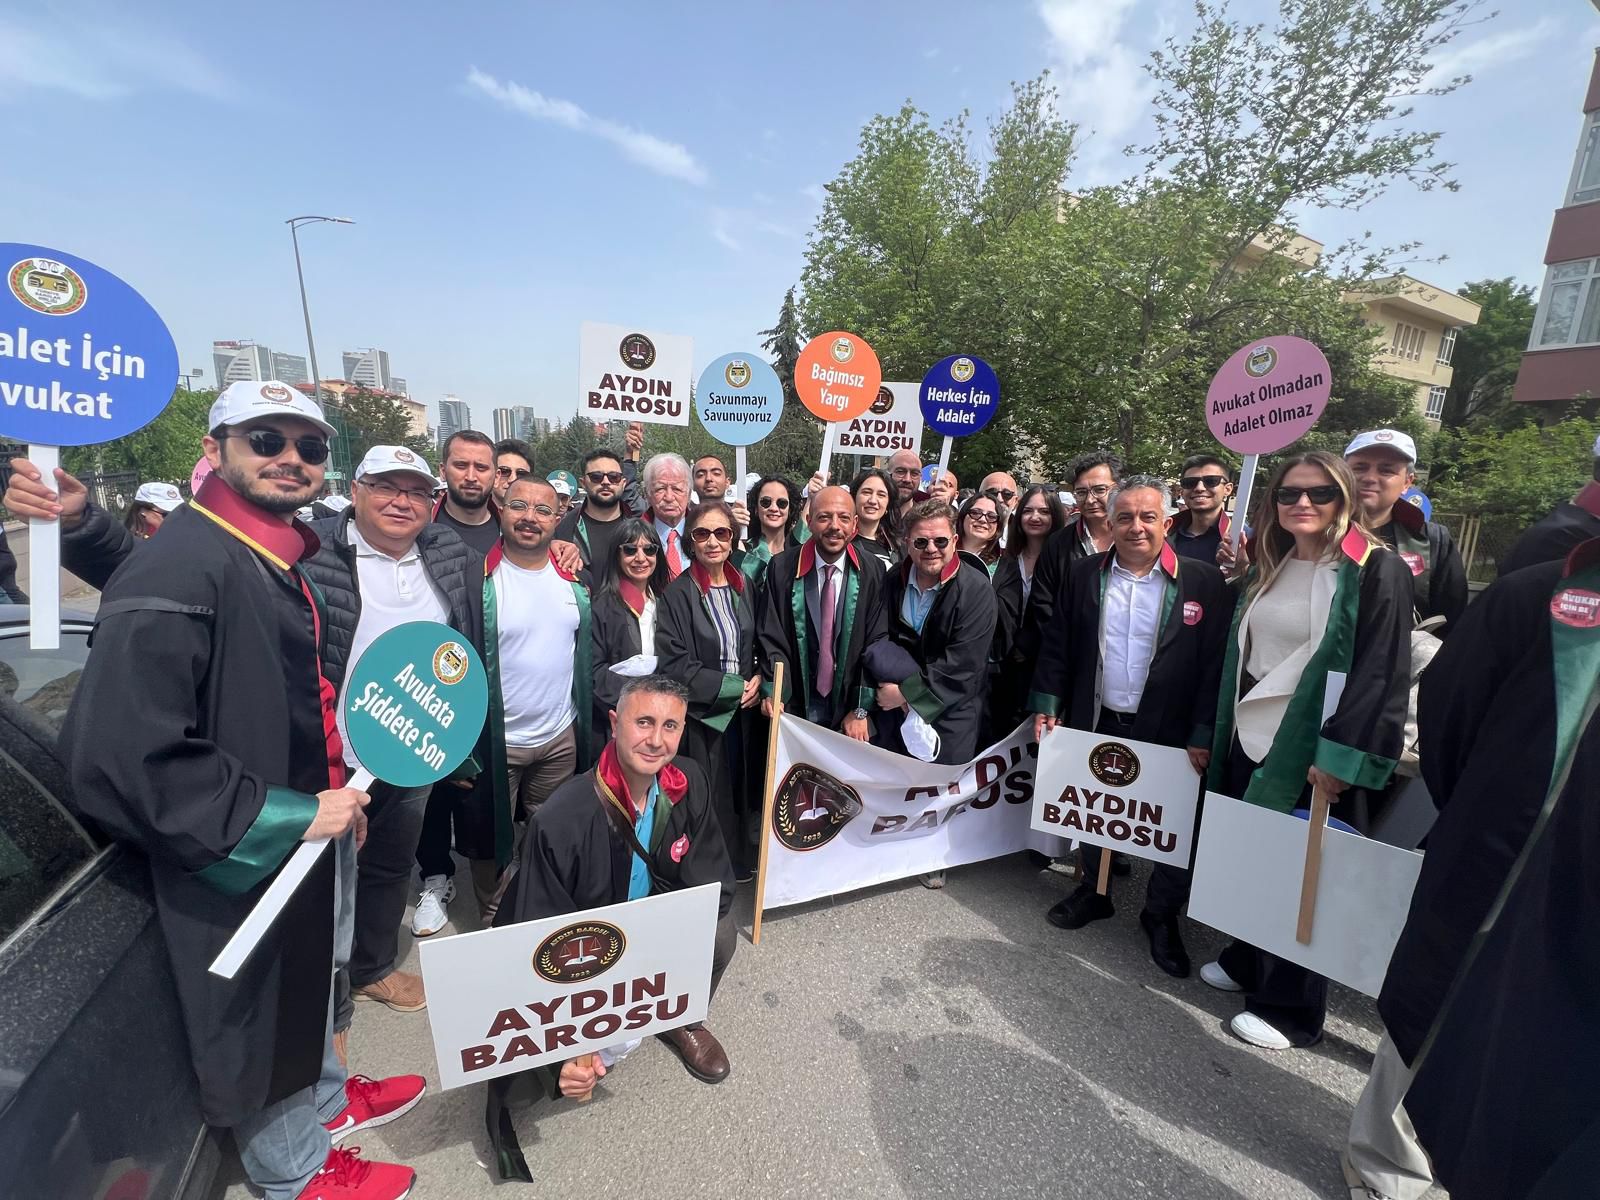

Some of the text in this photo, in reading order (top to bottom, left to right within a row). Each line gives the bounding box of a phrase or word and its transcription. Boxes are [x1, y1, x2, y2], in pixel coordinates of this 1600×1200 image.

[82, 333, 145, 380] İçin
[598, 373, 672, 397] AYDIN
[811, 363, 865, 388] Bağımsız
[588, 391, 682, 417] BAROSU
[709, 392, 767, 409] Savunmayı
[820, 388, 849, 412] Yargı
[927, 387, 991, 408] Herkes İçin
[1212, 373, 1323, 415] Avukat Olmadan
[704, 409, 772, 425] Savunuyoruz
[848, 419, 906, 434] AYDIN
[936, 408, 975, 425] Adalet
[1224, 404, 1313, 437] Adalet Olmaz
[840, 434, 914, 450] BAROSU
[393, 662, 455, 729] Avukata
[350, 681, 446, 771] Şiddete Son
[1058, 785, 1163, 826] AYDIN
[1043, 803, 1177, 852] BAROSU
[486, 972, 666, 1038] AYDIN
[461, 993, 689, 1072] BAROSU
